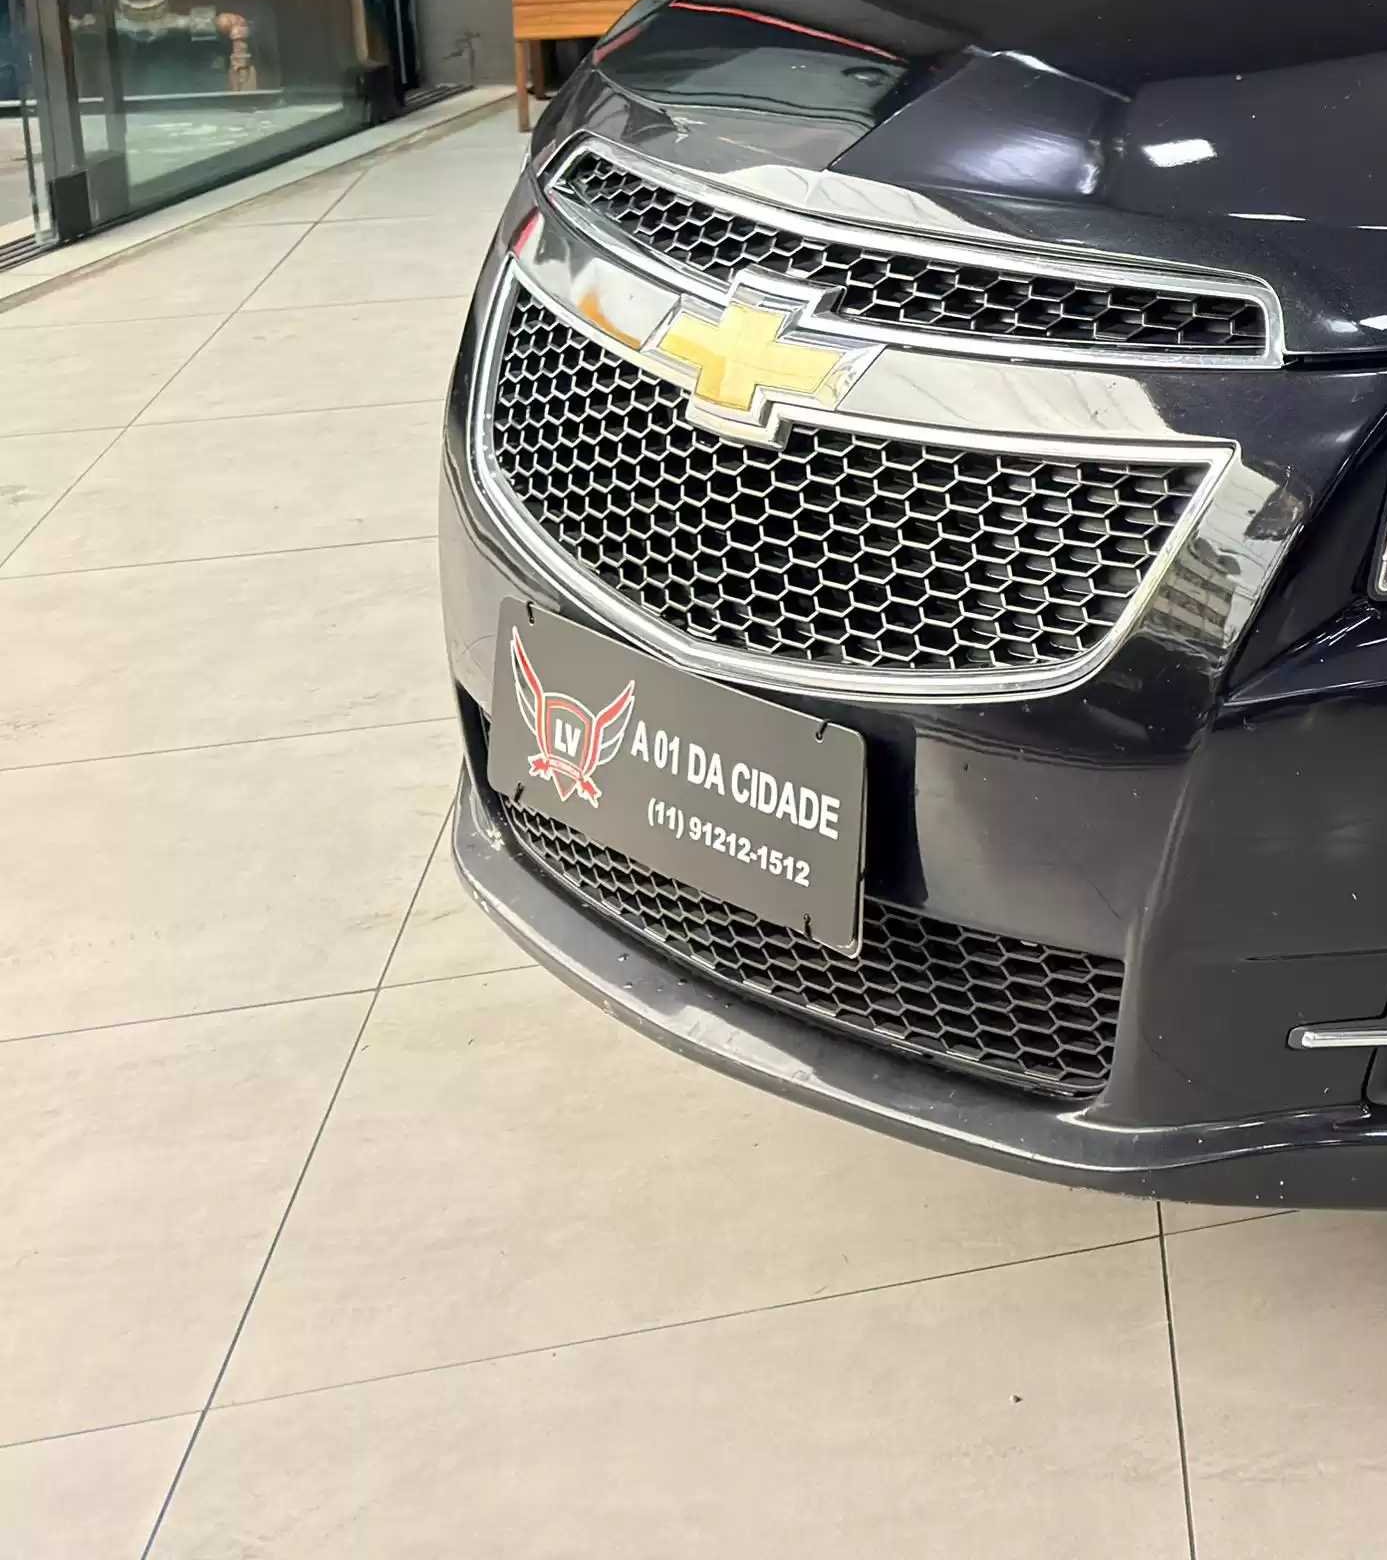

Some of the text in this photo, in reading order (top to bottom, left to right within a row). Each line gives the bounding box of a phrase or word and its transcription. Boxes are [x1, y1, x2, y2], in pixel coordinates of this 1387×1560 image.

[554, 718, 582, 757] LV
[630, 720, 841, 841] A 01 DA CIDADE
[647, 797, 811, 888] (11) 91212-1512
